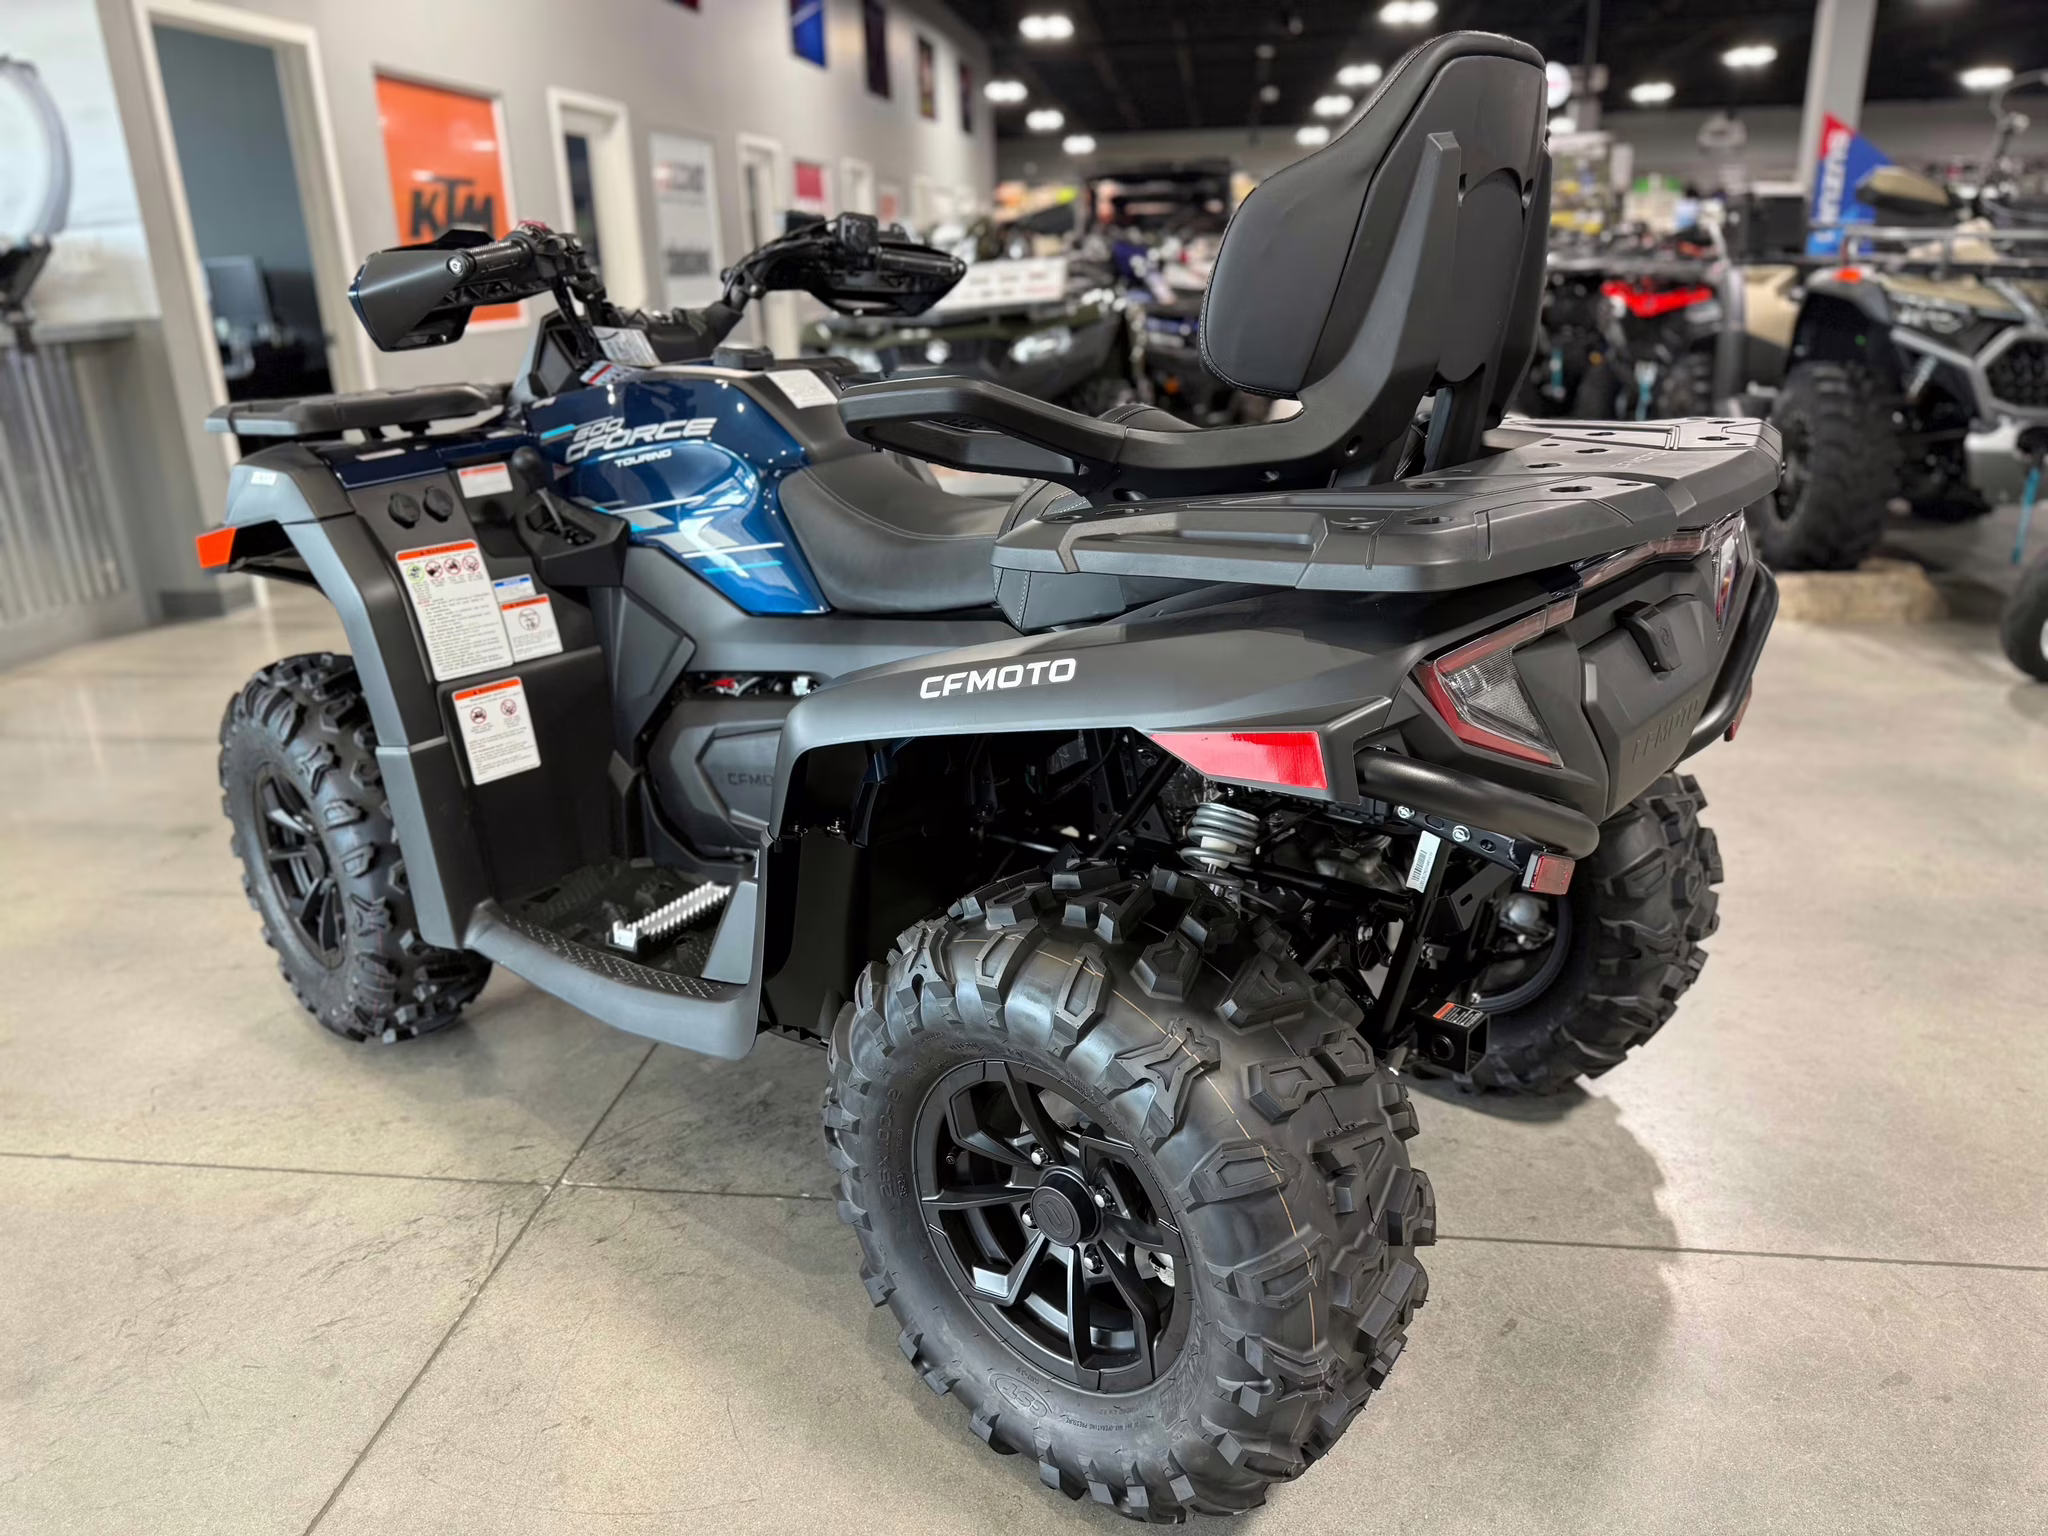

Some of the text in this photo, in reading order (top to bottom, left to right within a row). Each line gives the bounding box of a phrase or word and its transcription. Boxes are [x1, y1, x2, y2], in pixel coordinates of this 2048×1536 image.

[410, 174, 495, 241] KTM
[565, 417, 718, 464] CFORCE
[614, 448, 673, 468] TOURING
[919, 657, 1077, 700] CFMOTO
[1002, 1382, 1048, 1418] CST
